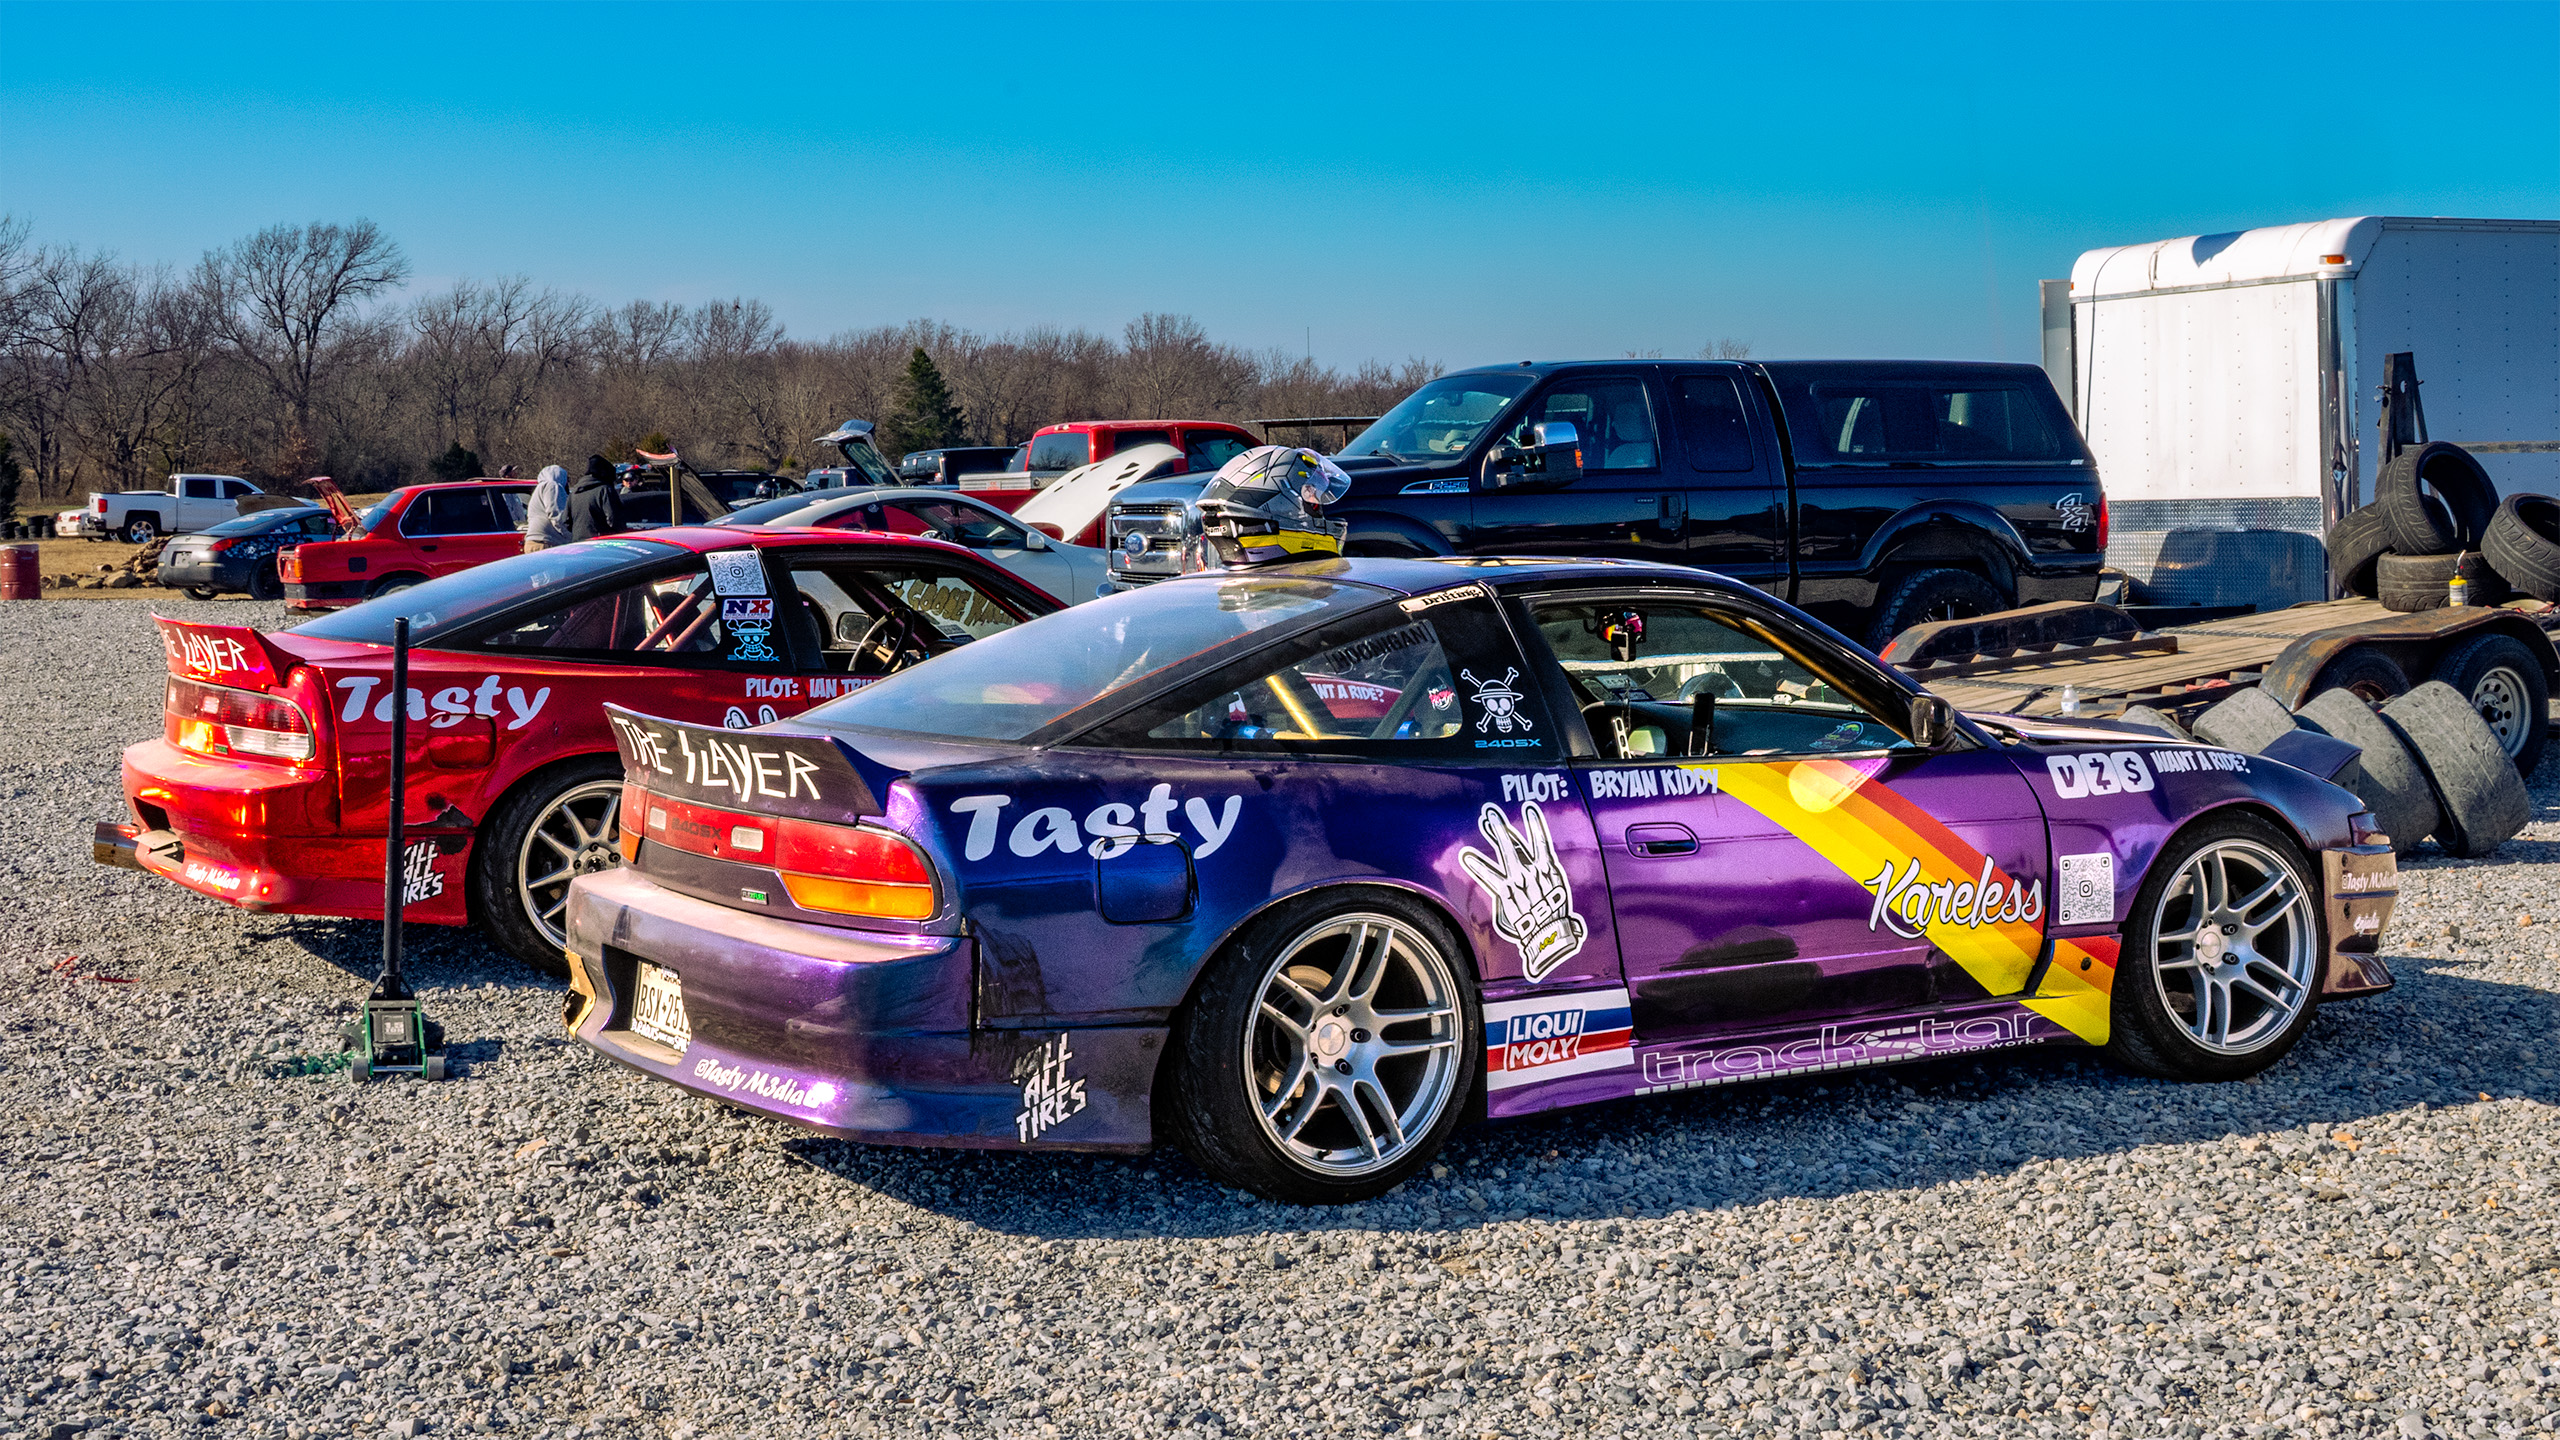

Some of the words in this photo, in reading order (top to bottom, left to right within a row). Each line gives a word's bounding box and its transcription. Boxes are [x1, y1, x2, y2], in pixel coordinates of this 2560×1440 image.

[725, 600, 771, 614] NX
[176, 628, 249, 676] SLAYER
[336, 675, 551, 730] Tasty
[745, 678, 799, 698] PILOT:
[809, 678, 838, 699] IAN
[1347, 685, 1385, 703] RIDE?
[613, 717, 673, 774] TIRE
[678, 730, 821, 802] SLAYER
[1474, 739, 1542, 748] 240SX
[2150, 750, 2199, 774] WANT
[2196, 753, 2213, 771] A
[2209, 753, 2251, 774] RIDE?
[1501, 773, 1568, 802] PILOT:
[1588, 769, 1658, 799] BRYAN
[1659, 767, 1719, 796] KIDDY
[671, 817, 723, 840] 240SX
[950, 783, 1242, 862] Tasty
[402, 873, 445, 907] IRES
[1864, 854, 2044, 939] Kareless
[1514, 886, 1568, 941] DBD
[638, 984, 663, 1023] BSX
[665, 993, 691, 1035] 251
[1512, 1011, 1580, 1041] LIQUI
[1509, 1037, 1577, 1070] MOLY
[1931, 1036, 2046, 1057] motorworks
[1024, 1061, 1071, 1109] ALL
[1016, 1078, 1087, 1144] TIRES
